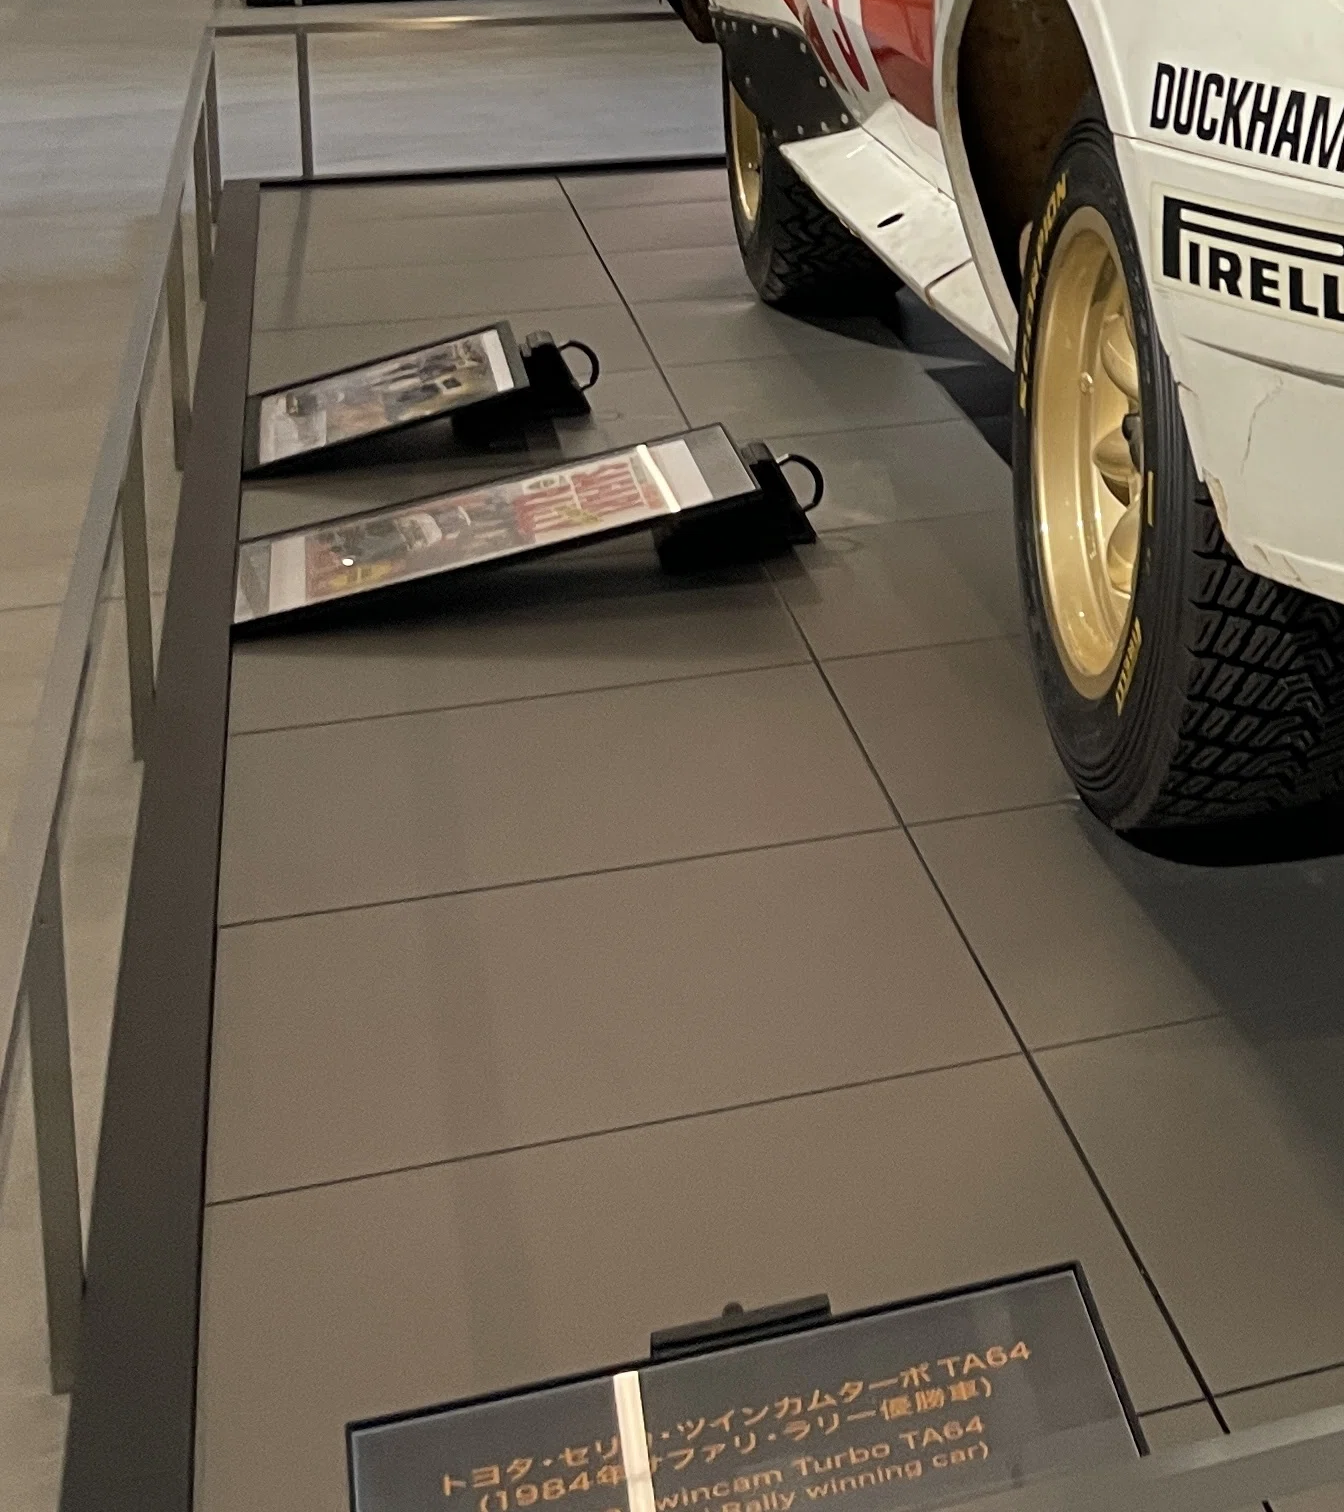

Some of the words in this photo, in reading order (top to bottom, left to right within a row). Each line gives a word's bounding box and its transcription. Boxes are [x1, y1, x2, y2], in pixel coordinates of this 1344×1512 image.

[443, 1361, 931, 1496] トヨタ・セリ・ツインカムターボ
[937, 1340, 1031, 1378] TA64
[655, 1467, 782, 1512] wincam
[791, 1440, 891, 1478] Turbo
[899, 1414, 984, 1451] TA64
[805, 1458, 923, 1501] winning
[932, 1439, 989, 1470] car)
